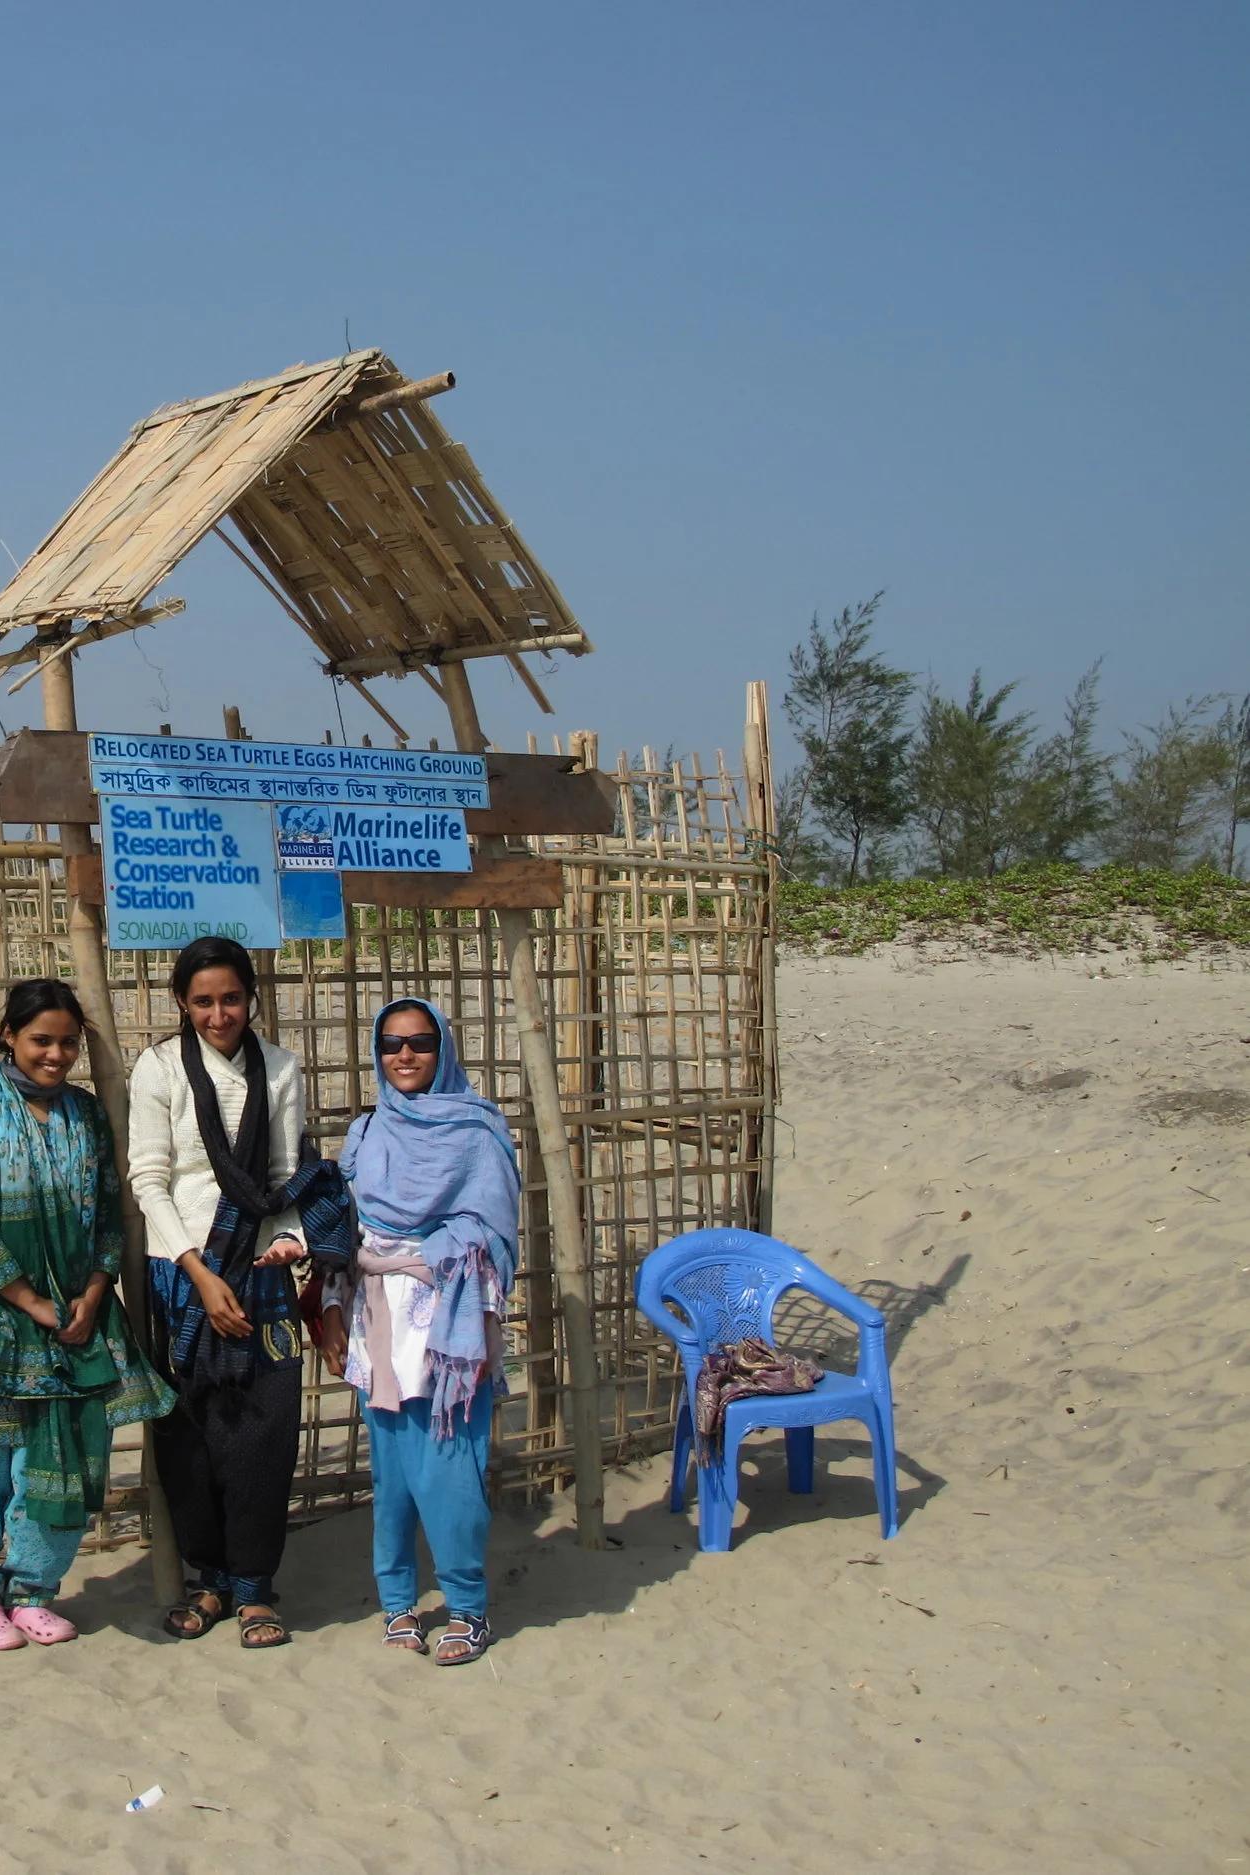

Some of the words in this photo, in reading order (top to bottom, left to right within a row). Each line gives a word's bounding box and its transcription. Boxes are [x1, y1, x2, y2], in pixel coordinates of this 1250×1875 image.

[178, 771, 250, 794] কাছিমের
[345, 778, 377, 799] ডিম
[110, 804, 152, 829] Sea
[155, 806, 223, 832] Turtle
[333, 812, 461, 841] Marinelife
[113, 831, 216, 857] Research
[221, 834, 241, 858] &
[280, 845, 333, 855] MARINELIFE
[337, 840, 441, 868] Alliance
[114, 858, 260, 885] Conservation
[282, 858, 334, 867] ALLIANCE
[116, 884, 195, 910] Station
[118, 921, 190, 940] SONADIA
[194, 922, 248, 940] ISLAND
